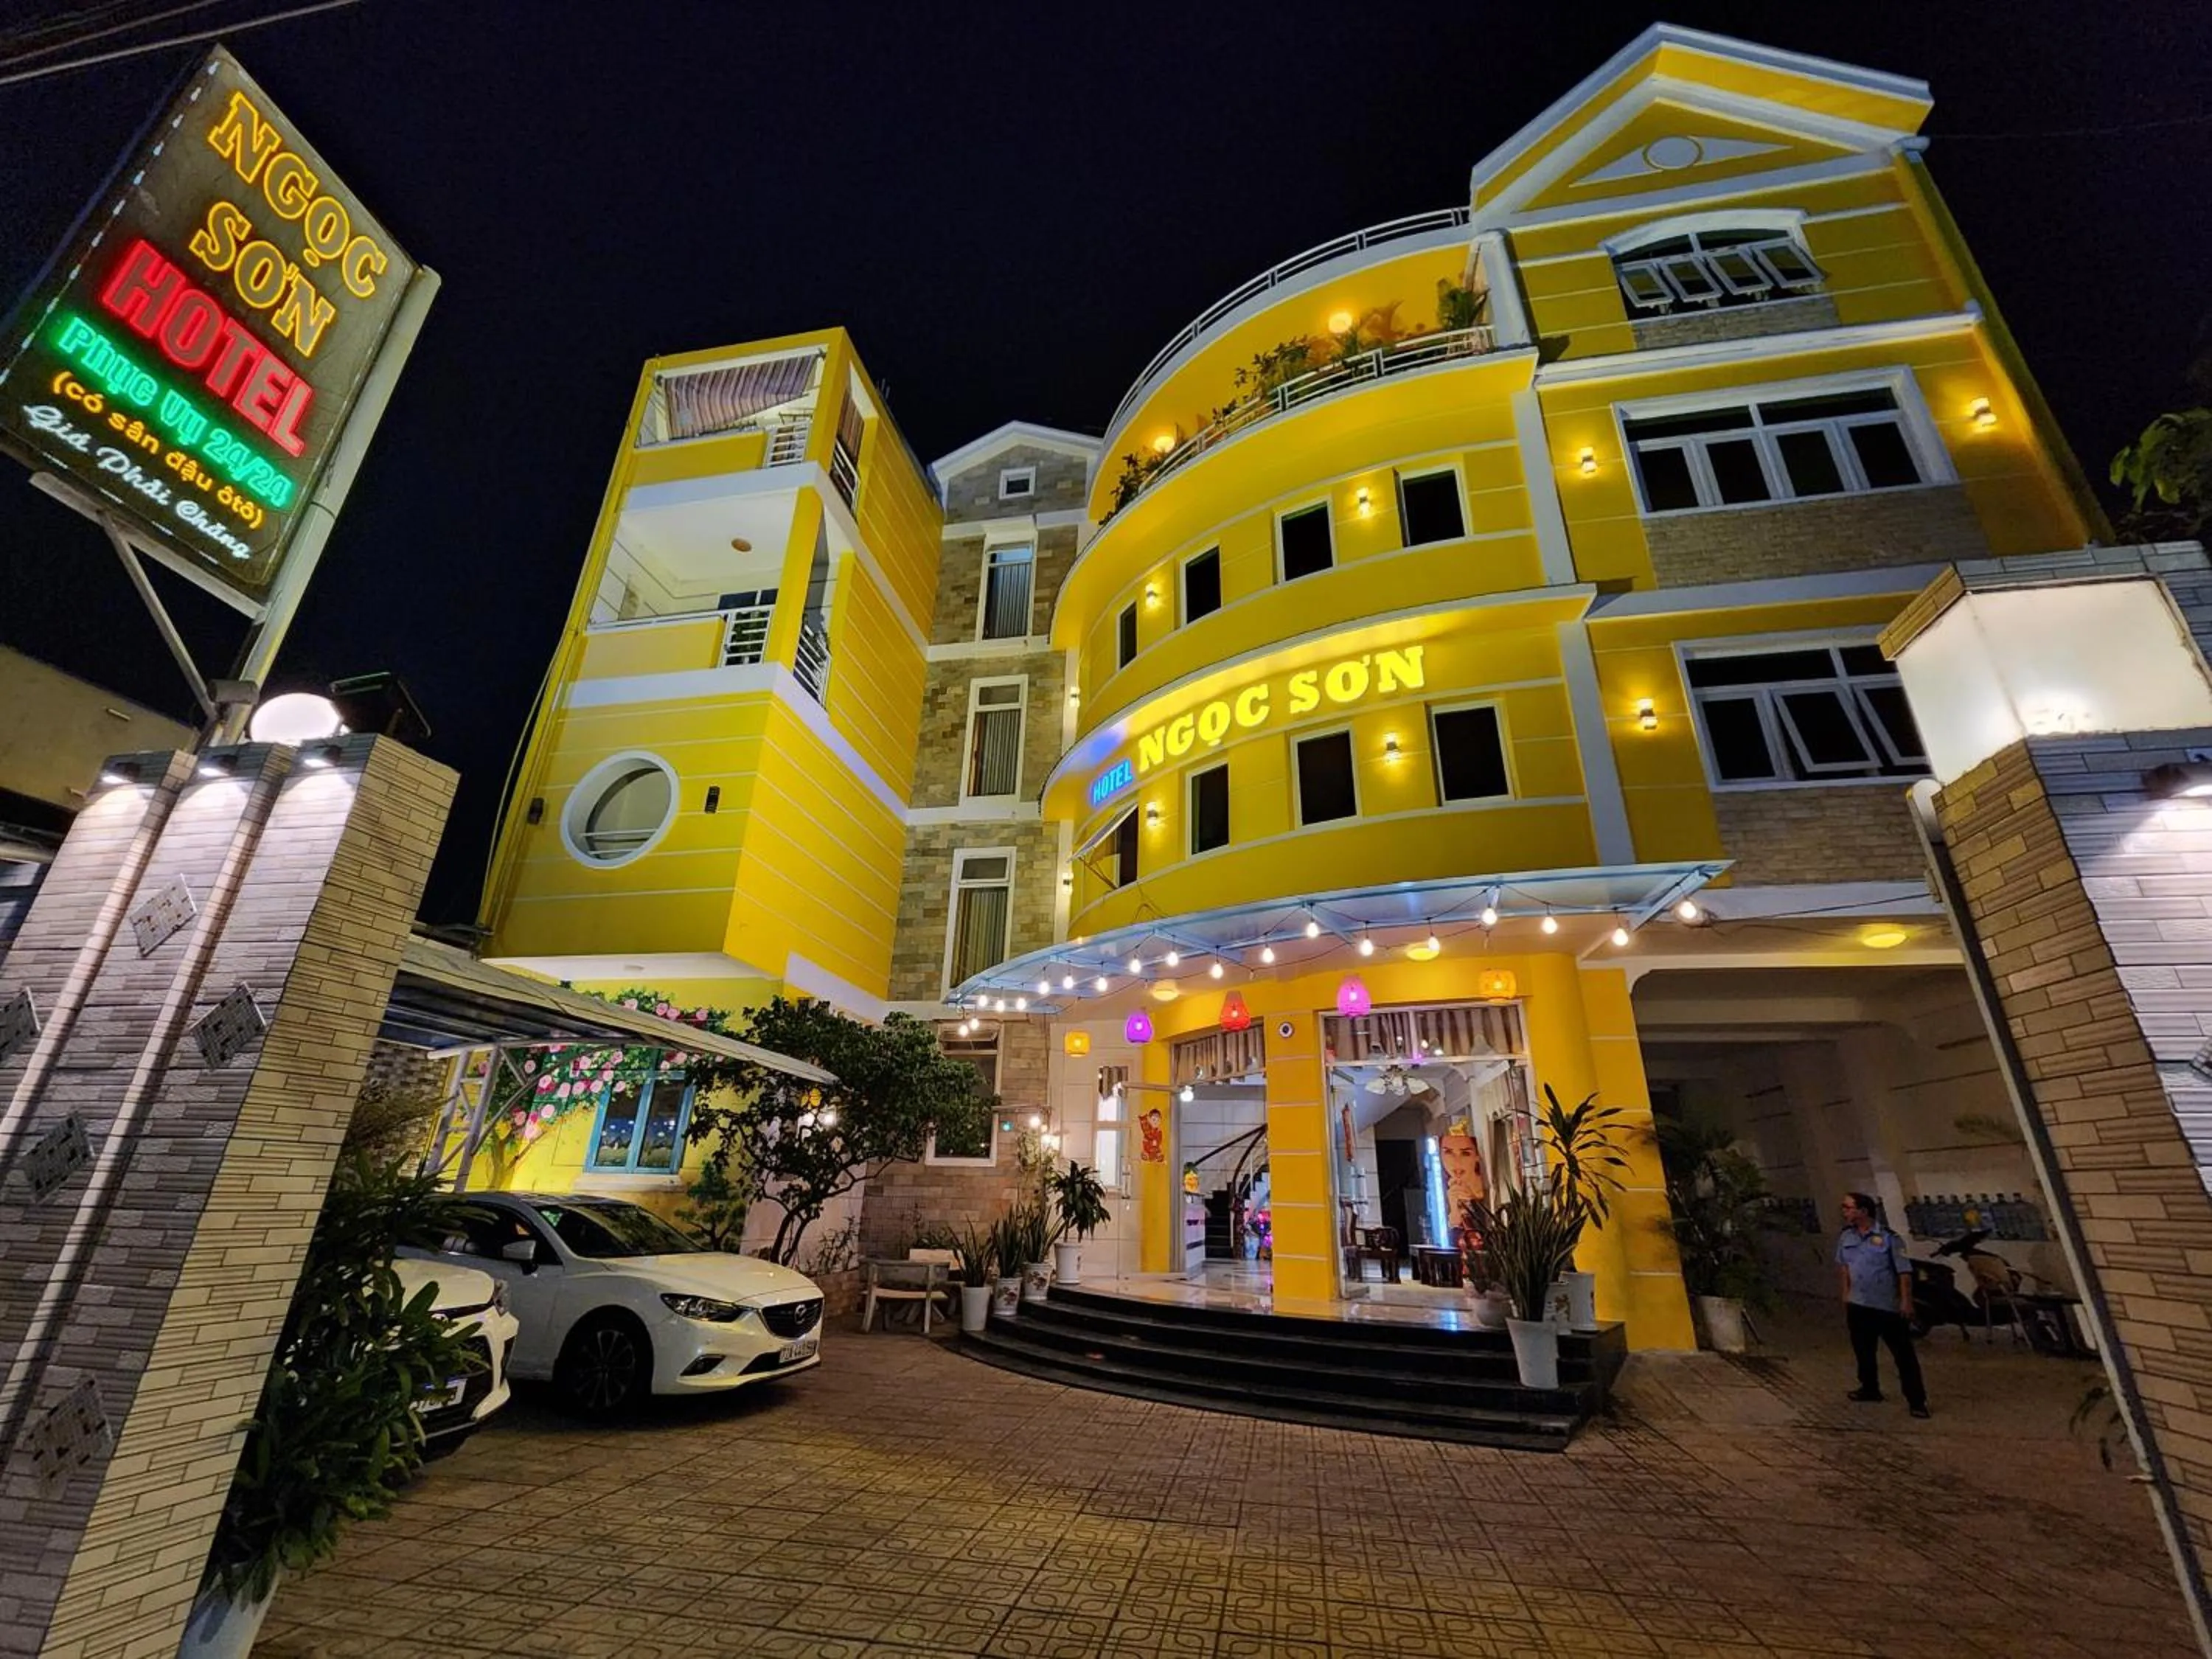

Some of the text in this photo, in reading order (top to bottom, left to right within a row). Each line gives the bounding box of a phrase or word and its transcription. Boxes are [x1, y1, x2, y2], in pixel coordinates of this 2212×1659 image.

[189, 202, 335, 356] SƠN
[209, 92, 387, 298] NGỌC
[52, 370, 104, 414] (có
[108, 411, 160, 454] sân
[59, 316, 158, 406] Phục
[202, 428, 293, 508] 24/24
[102, 240, 313, 457] HOTEL
[1093, 646, 1424, 804] HOTEL NGỌC SƠN
